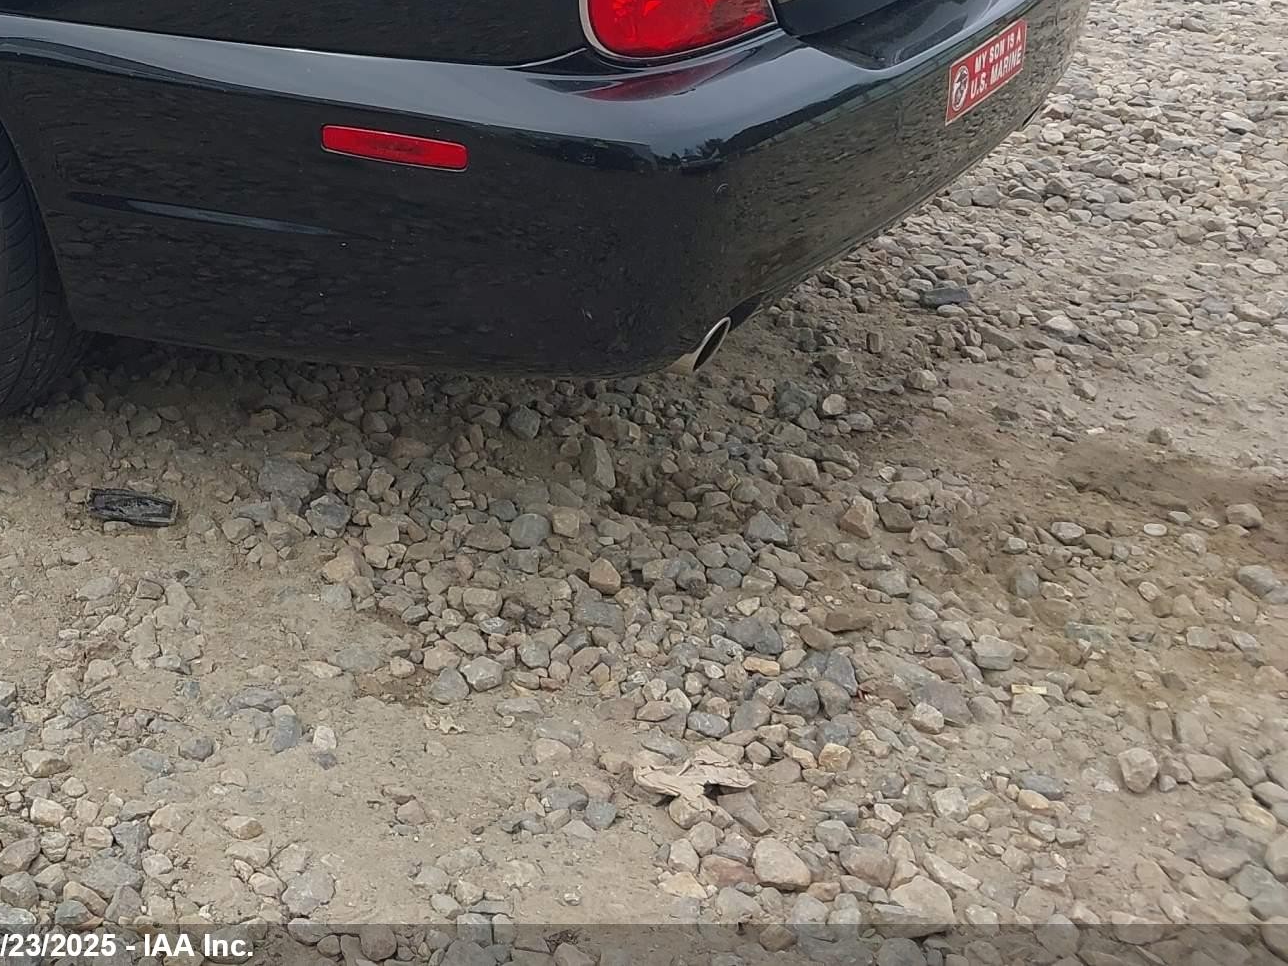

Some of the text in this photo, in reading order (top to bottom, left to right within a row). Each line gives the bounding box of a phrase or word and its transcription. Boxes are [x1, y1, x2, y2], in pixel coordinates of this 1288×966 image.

[970, 45, 1023, 99] U.S. MARINE
[974, 26, 1022, 74] MY SON IS A
